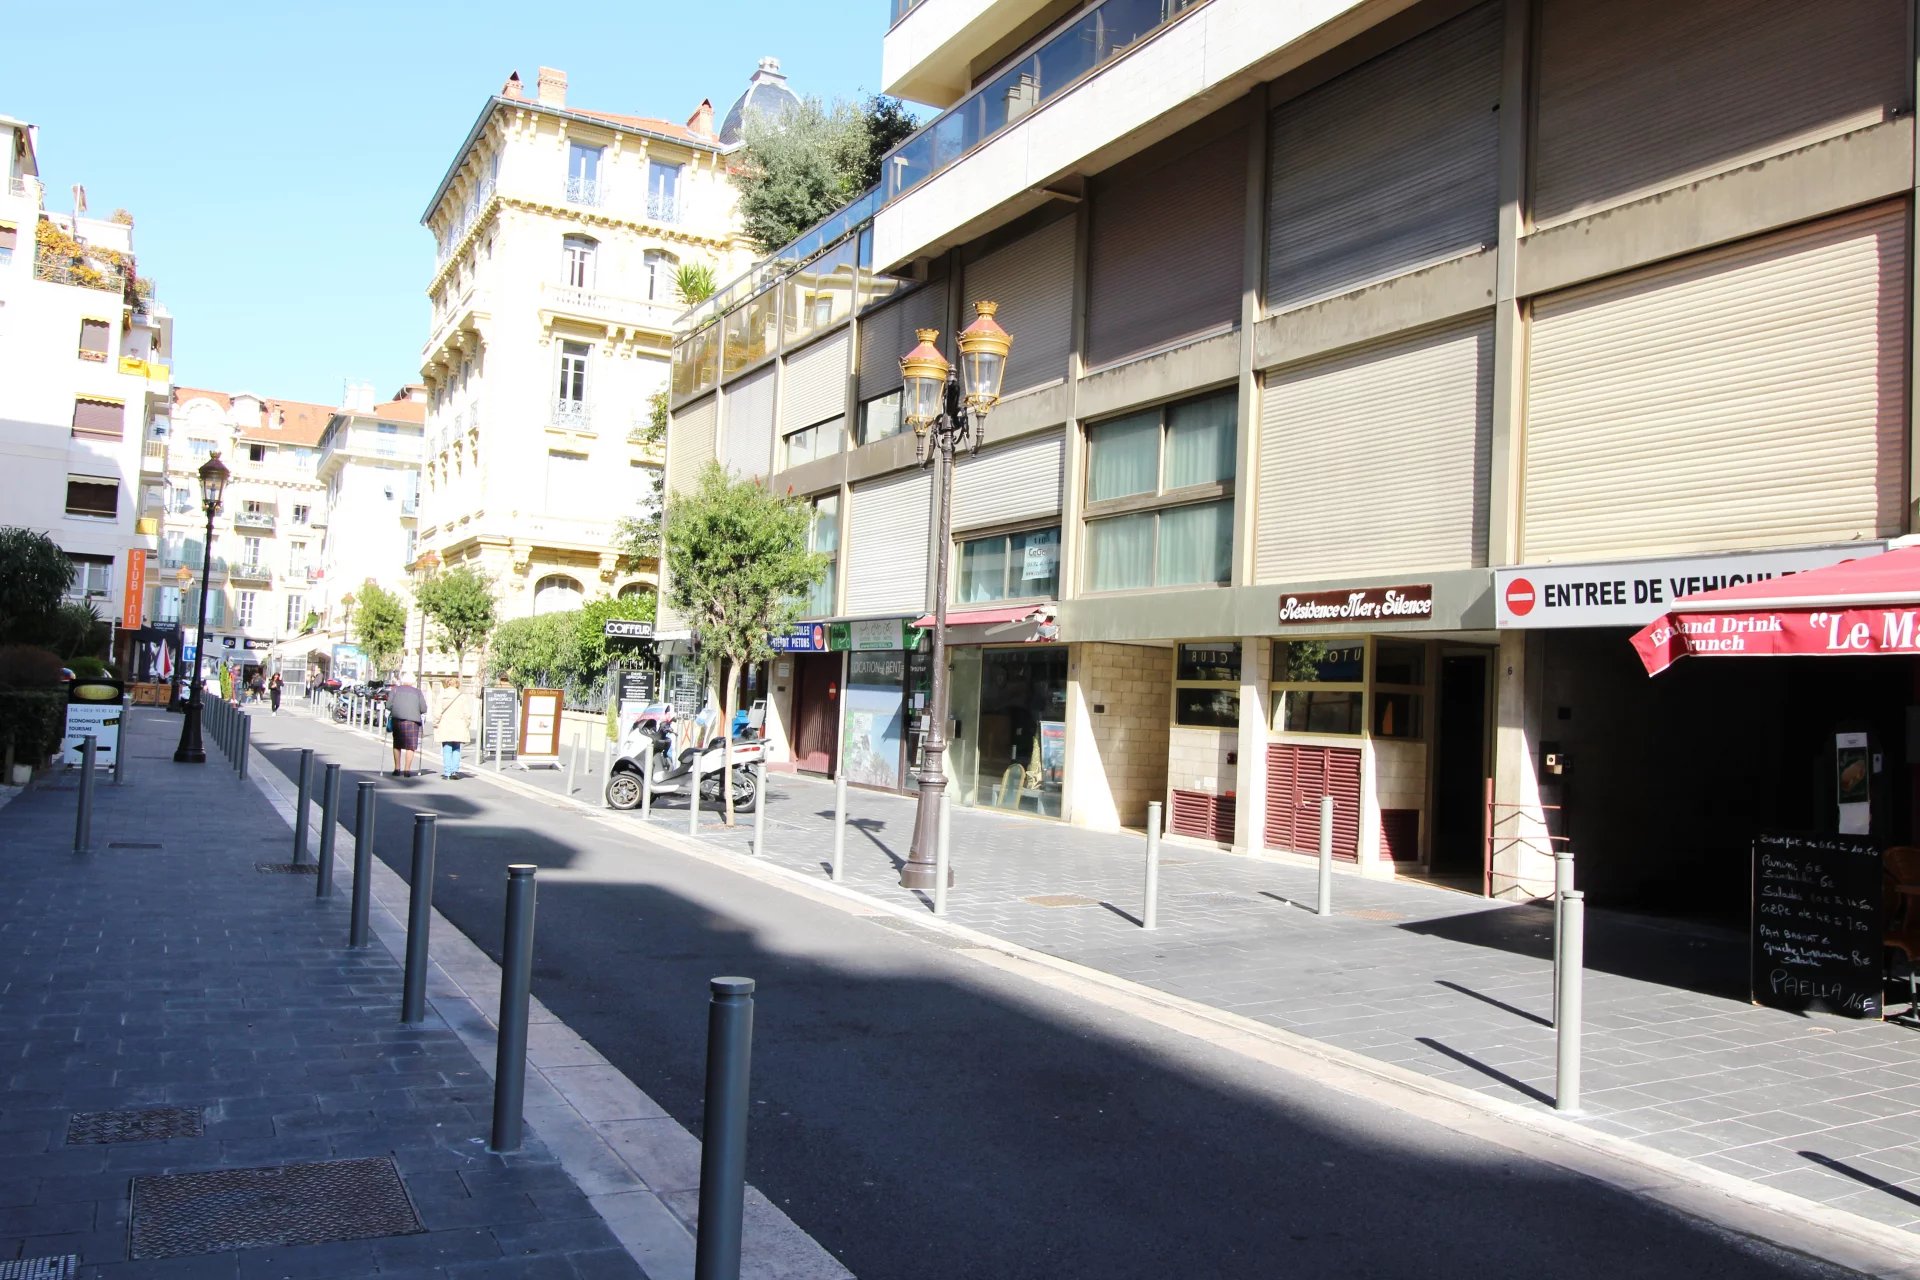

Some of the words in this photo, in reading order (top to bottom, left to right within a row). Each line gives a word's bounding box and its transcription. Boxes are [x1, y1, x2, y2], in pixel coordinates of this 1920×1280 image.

[131, 551, 141, 591] CLUB
[1340, 592, 1375, 617] Mer
[1382, 590, 1432, 616] Silence
[1544, 580, 1627, 607] ENTREE
[1634, 579, 1663, 604] DE
[607, 623, 651, 636] COIFFEUR
[1680, 617, 1716, 634] and
[1722, 615, 1783, 633] Drink
[1507, 666, 1513, 676] 6
[1770, 968, 1843, 999] PAELLA
